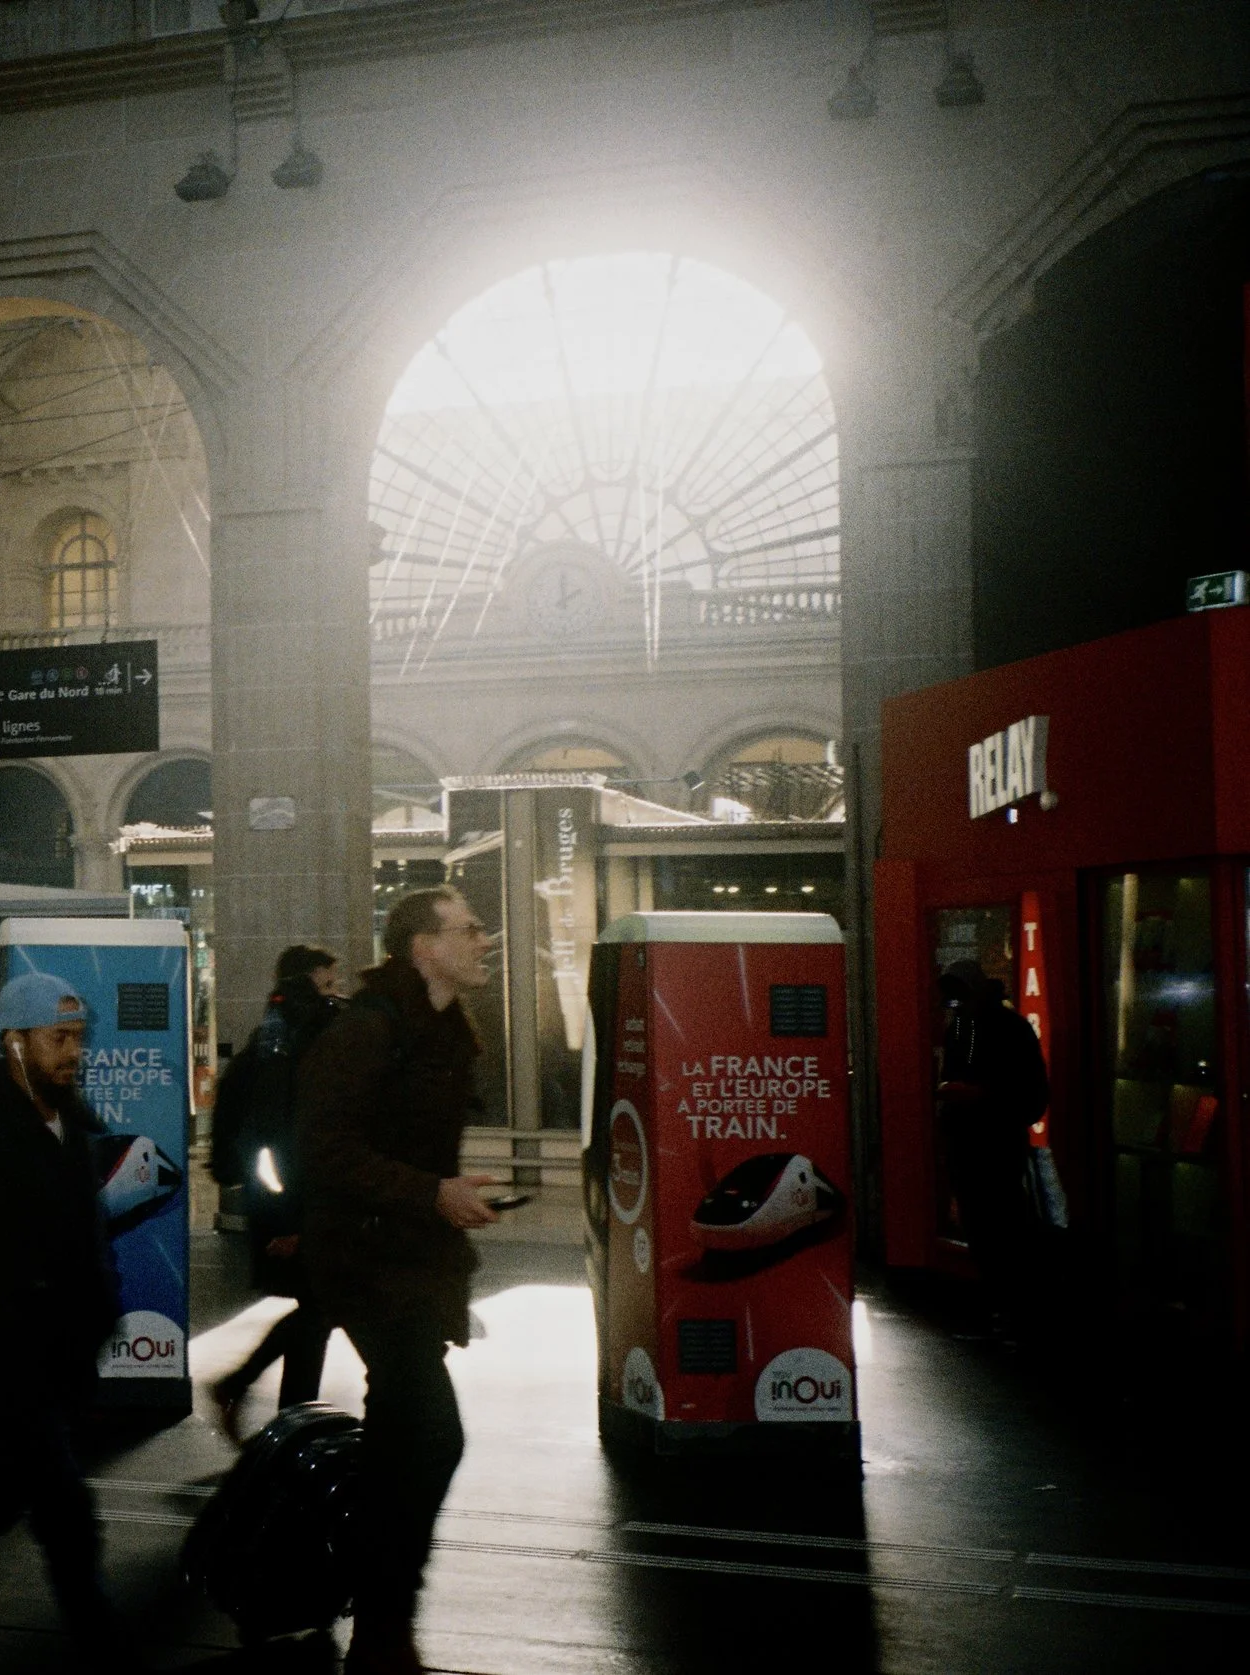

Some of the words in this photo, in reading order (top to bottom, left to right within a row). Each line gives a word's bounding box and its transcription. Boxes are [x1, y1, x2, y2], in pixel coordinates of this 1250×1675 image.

[8, 689, 37, 701] Gare
[39, 688, 55, 699] du
[58, 685, 90, 698] Nord
[2, 720, 41, 736] lignes
[968, 715, 1042, 820] RELAY
[547, 807, 578, 896] Bruges
[79, 1047, 163, 1067] RANCE
[682, 1062, 705, 1077] LA
[710, 1055, 819, 1077] FRANCE
[120, 1087, 143, 1100] DE
[692, 1082, 715, 1098] ET
[720, 1079, 831, 1098] L'EUROPE
[773, 1100, 798, 1114] DE
[686, 1116, 787, 1139] TRAIN.
